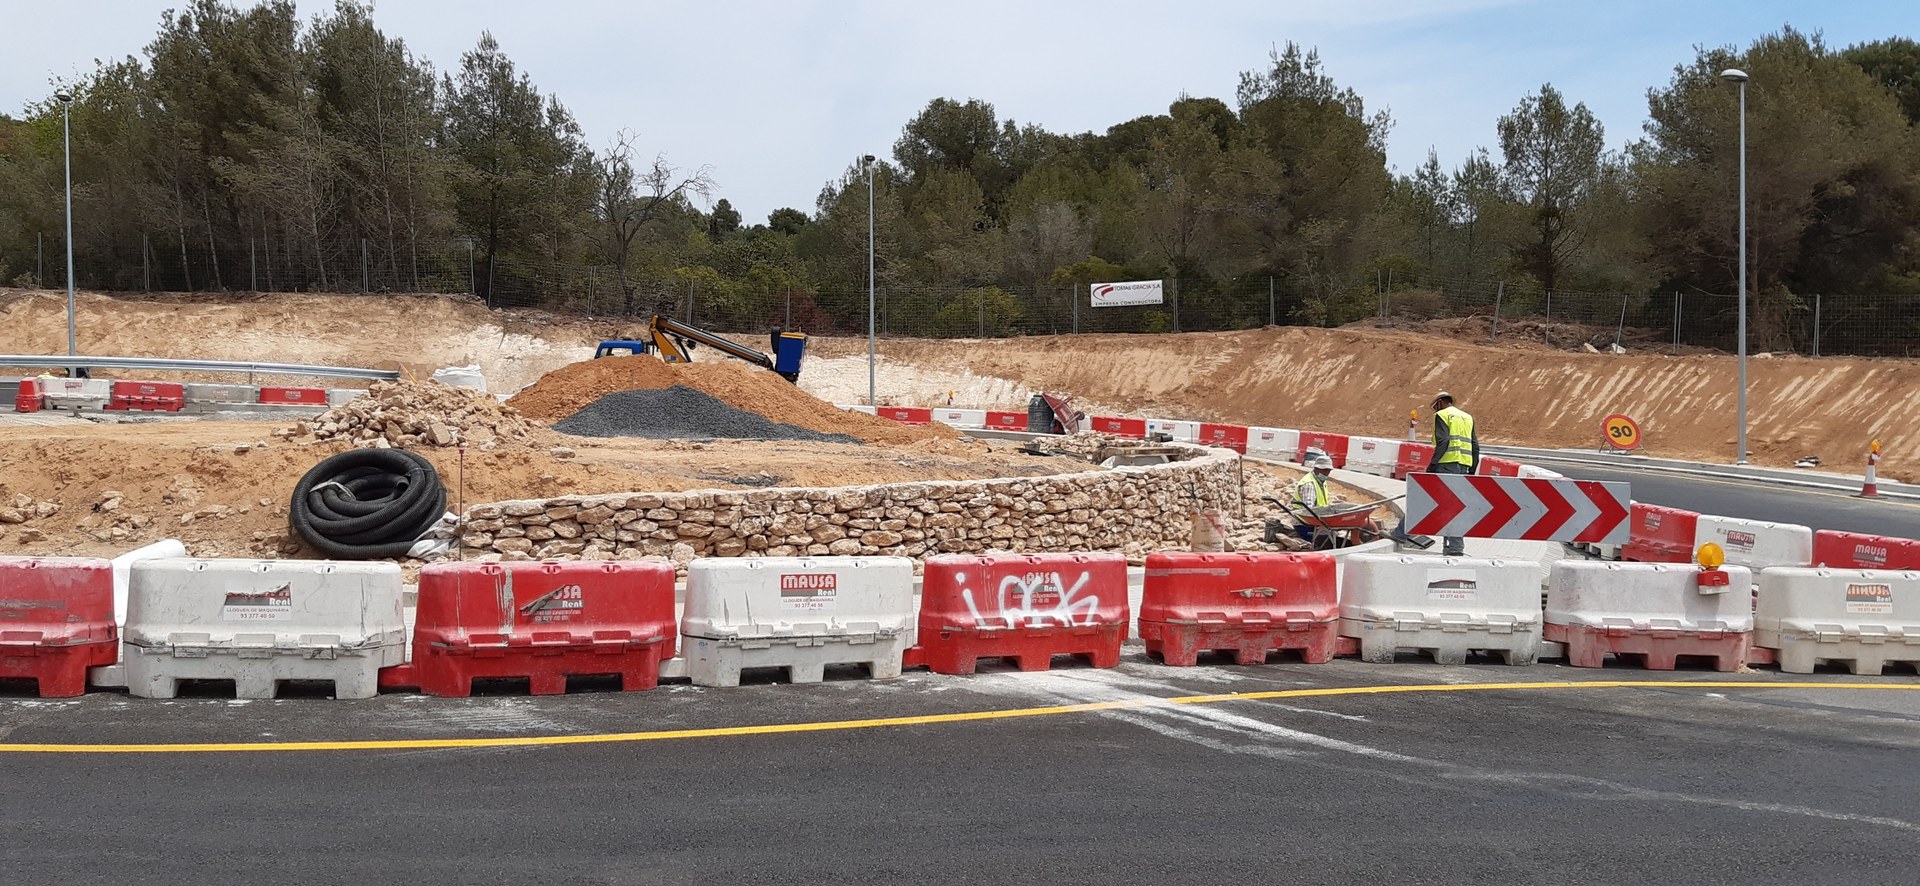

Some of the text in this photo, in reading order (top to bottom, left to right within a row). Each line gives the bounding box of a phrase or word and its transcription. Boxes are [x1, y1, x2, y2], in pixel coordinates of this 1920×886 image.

[1610, 425, 1632, 438] 30
[1855, 544, 1887, 556] MAUSA
[782, 575, 834, 588] MAUSA
[562, 600, 583, 608] Rent
